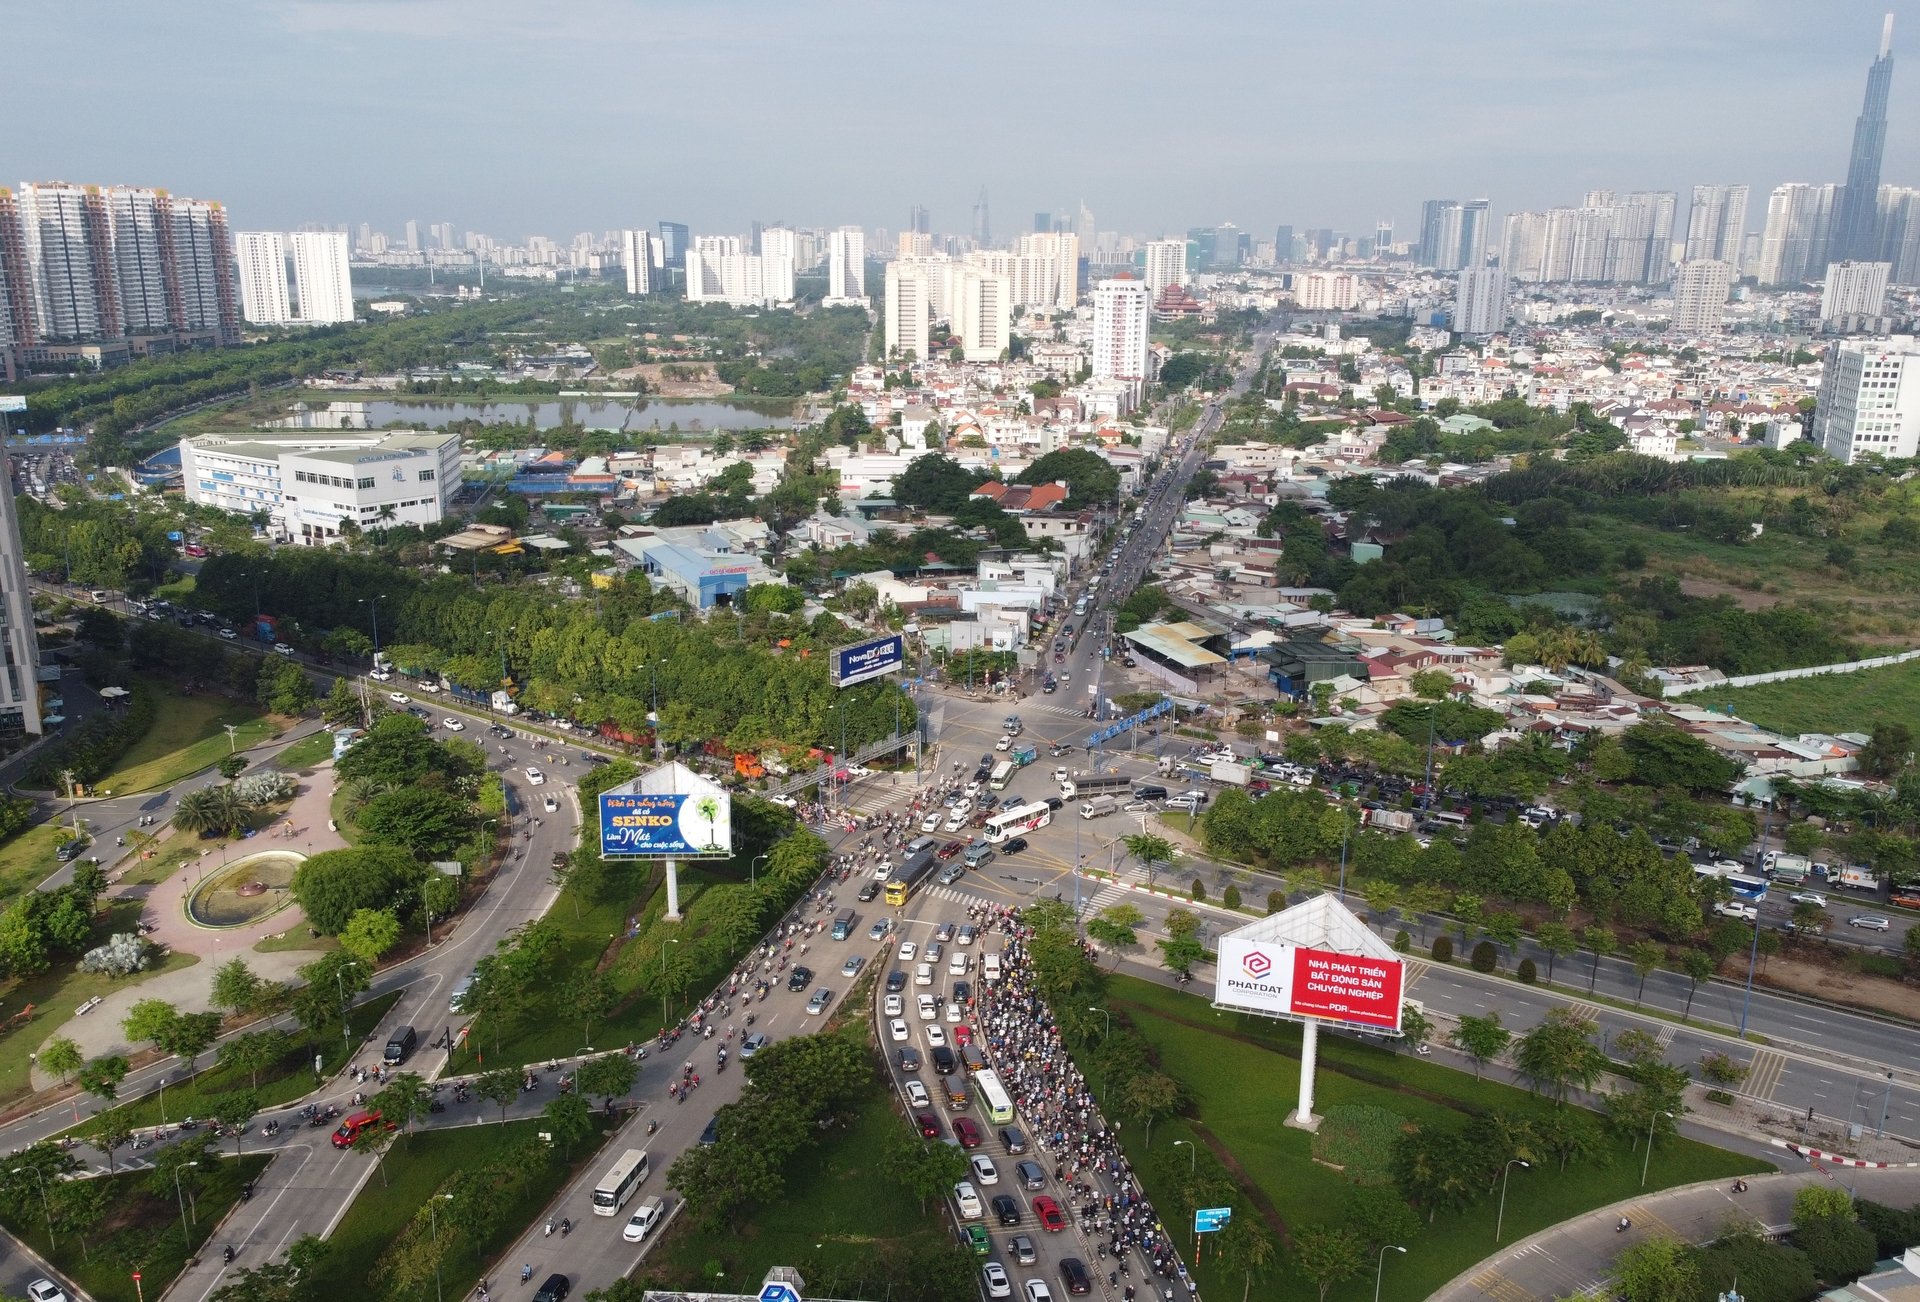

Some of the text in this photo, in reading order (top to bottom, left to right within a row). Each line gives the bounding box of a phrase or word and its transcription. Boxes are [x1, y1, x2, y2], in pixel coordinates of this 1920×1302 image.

[612, 815, 673, 827] SENKO
[653, 841, 668, 849] cuộc
[669, 840, 685, 849] sống
[1308, 960, 1387, 978] NHÀ PHÁT TRIỂN
[1227, 979, 1284, 994] PHATDAT
[1310, 971, 1382, 989] BẤT ĐỘNG SẢN
[1232, 987, 1278, 999] CORPORATION
[1307, 982, 1384, 1000] CHUYÊN NGHIỆP
[1329, 1003, 1348, 1012] PDR
